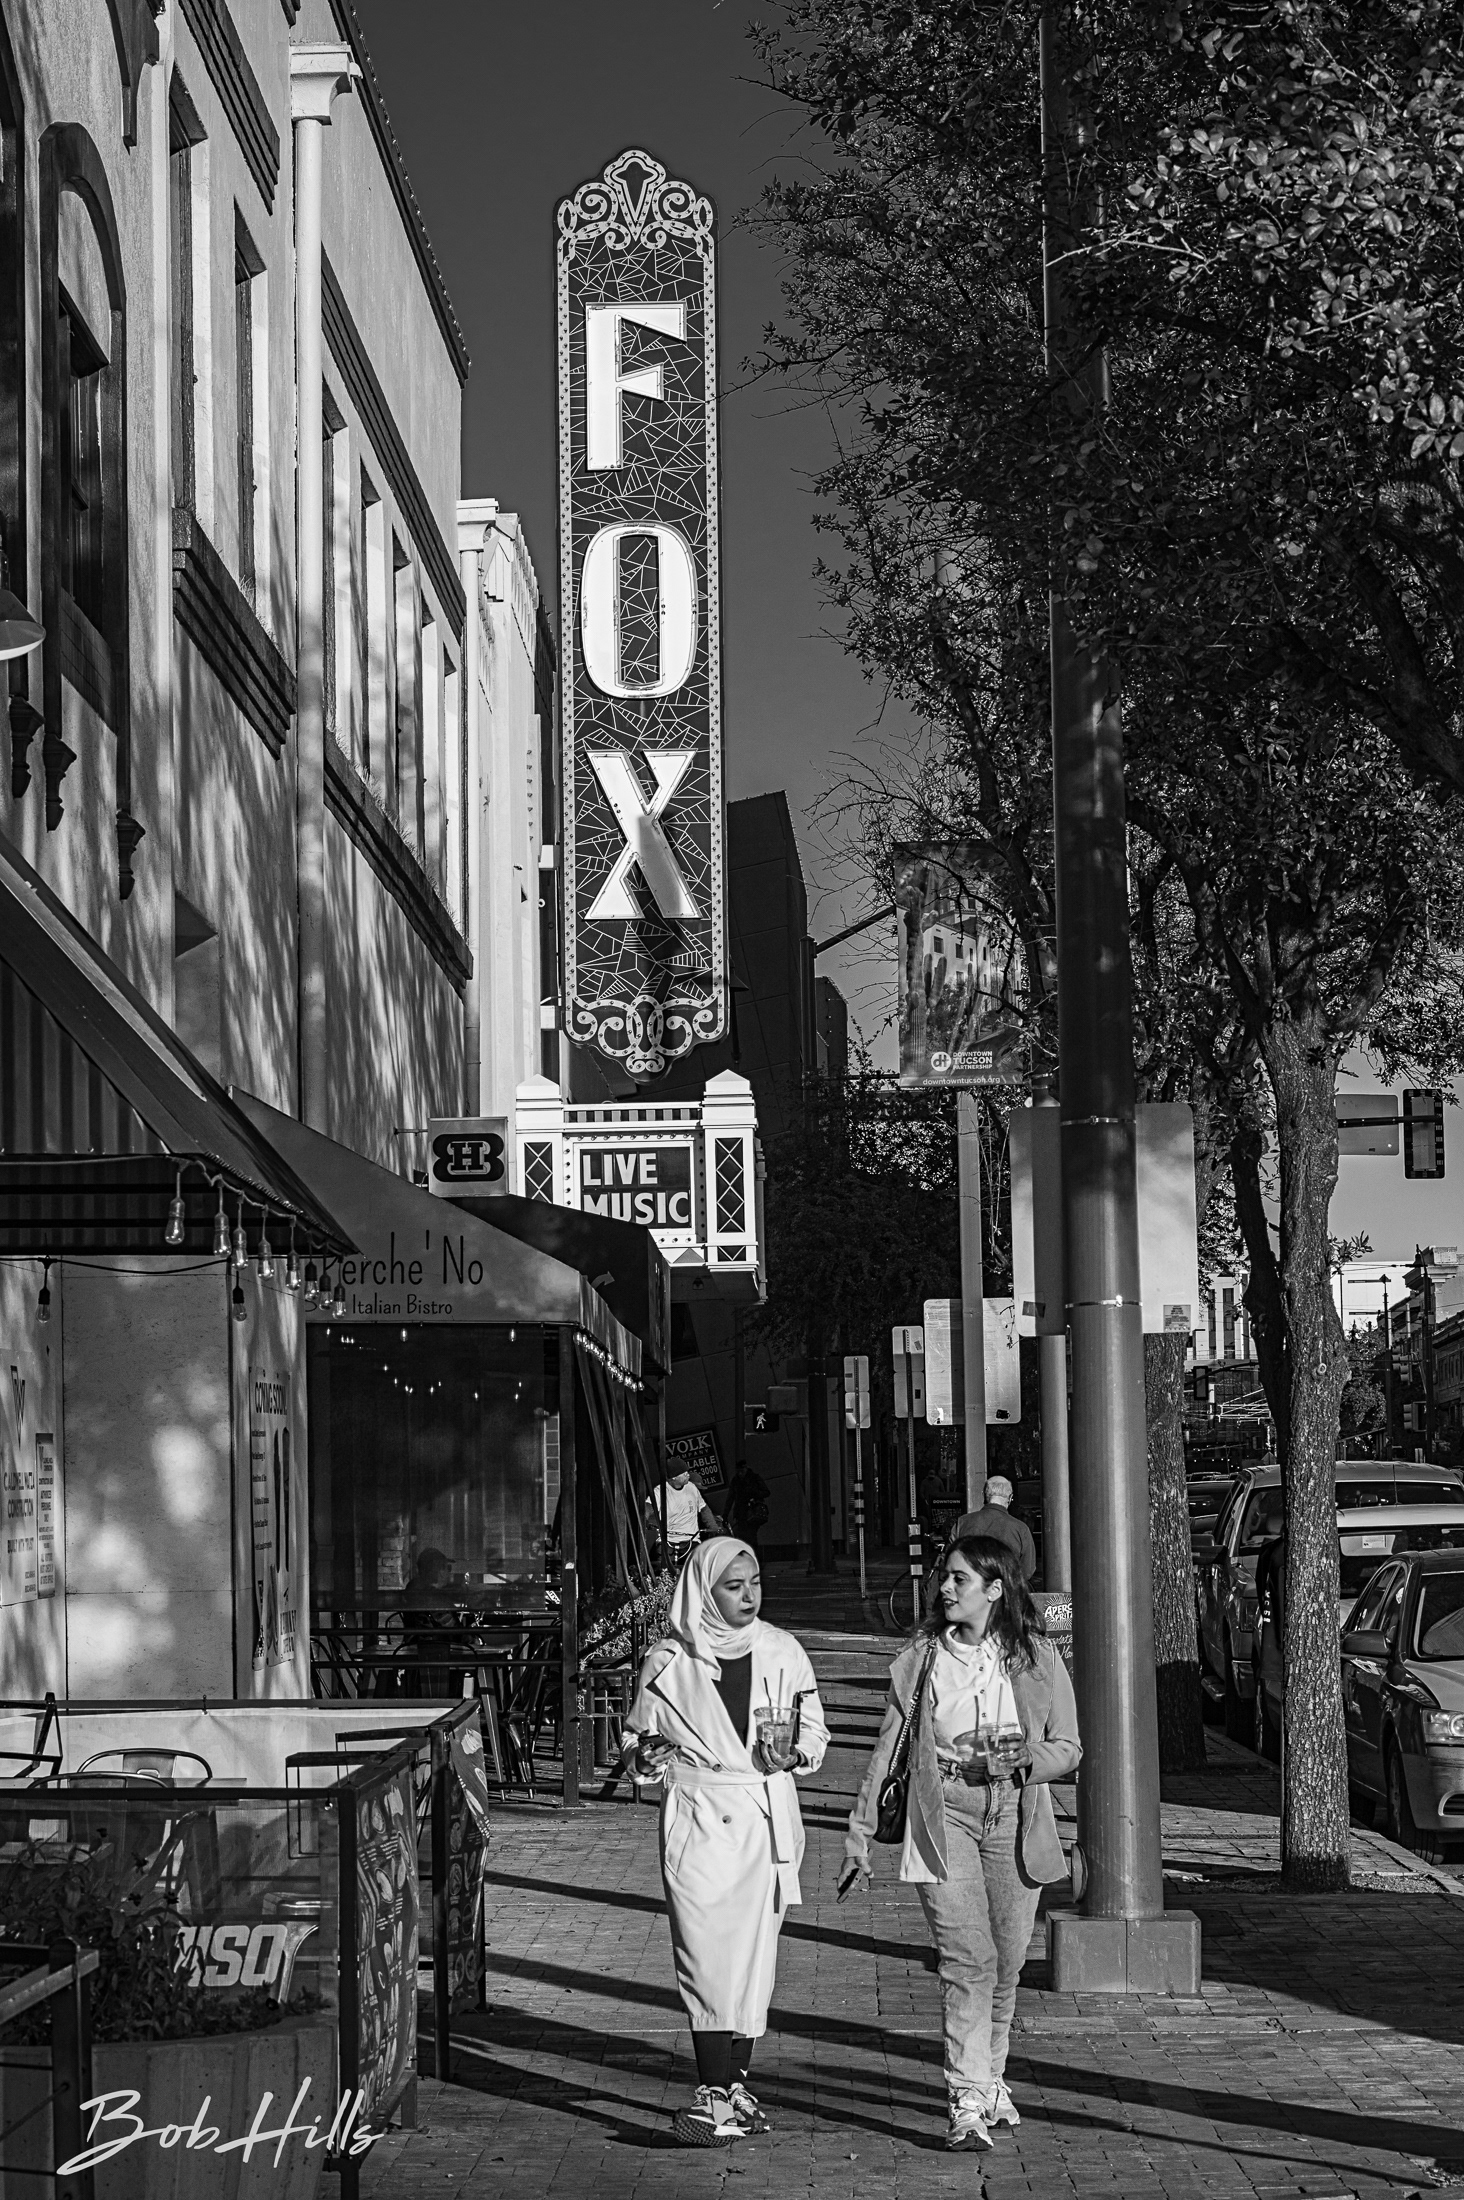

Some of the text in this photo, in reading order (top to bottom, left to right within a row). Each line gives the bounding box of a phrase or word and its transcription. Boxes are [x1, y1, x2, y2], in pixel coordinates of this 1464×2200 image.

[581, 301, 702, 921] FOX
[953, 1057, 993, 1065] TUCSON
[922, 1076, 1001, 1086] downtowntucson.org
[582, 1152, 658, 1186] LIVE
[583, 1191, 689, 1225] MUSIC
[352, 1292, 401, 1315] Italian
[406, 1293, 453, 1315] Bistro
[665, 1434, 711, 1456] VOLK
[685, 1455, 717, 1469] LABLE
[702, 1476, 717, 1486] OLK
[1044, 1602, 1073, 1618] APERO
